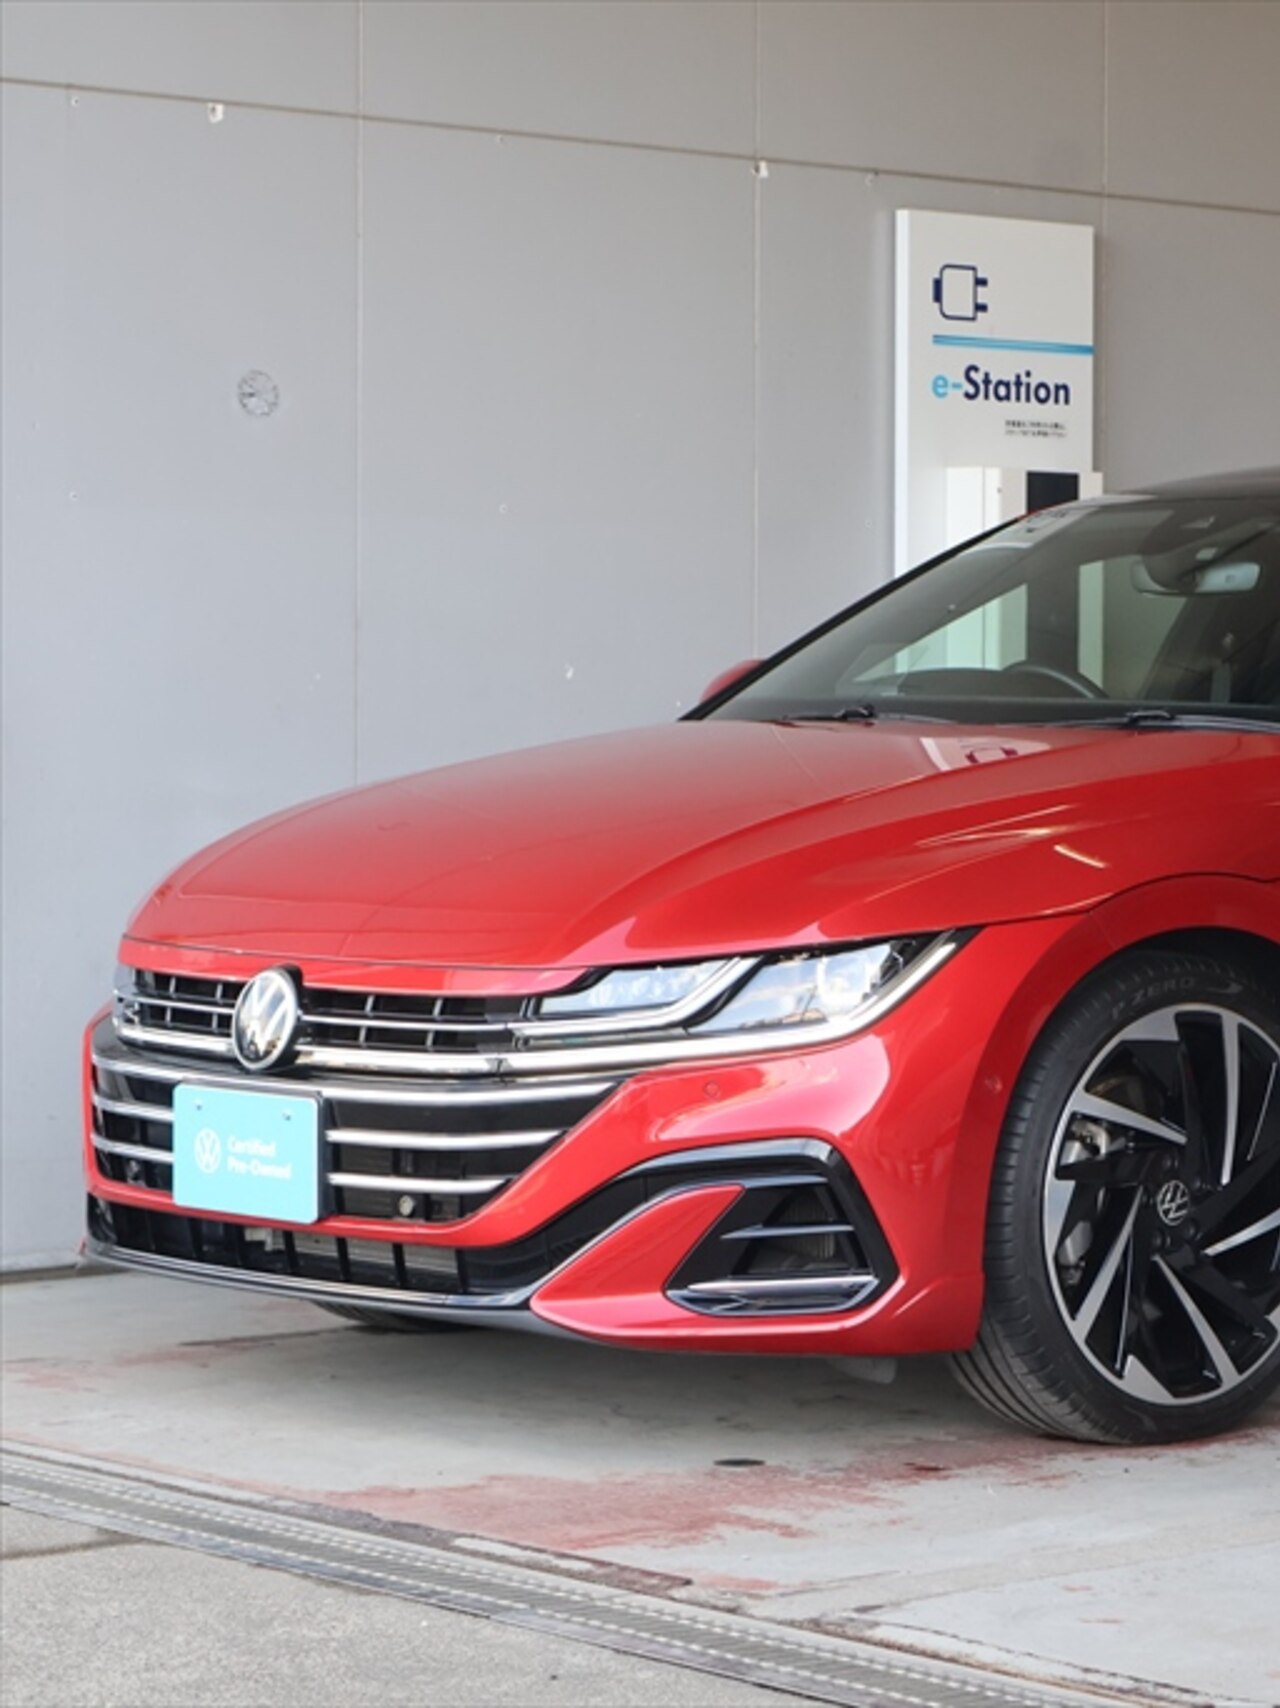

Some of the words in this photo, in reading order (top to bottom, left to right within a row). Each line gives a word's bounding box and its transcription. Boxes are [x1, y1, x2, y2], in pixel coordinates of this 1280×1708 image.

[932, 364, 1070, 406] e-Station
[1132, 977, 1195, 1005] ZERO
[228, 1136, 277, 1157] Certified
[228, 1157, 292, 1180] Pre-Owned
